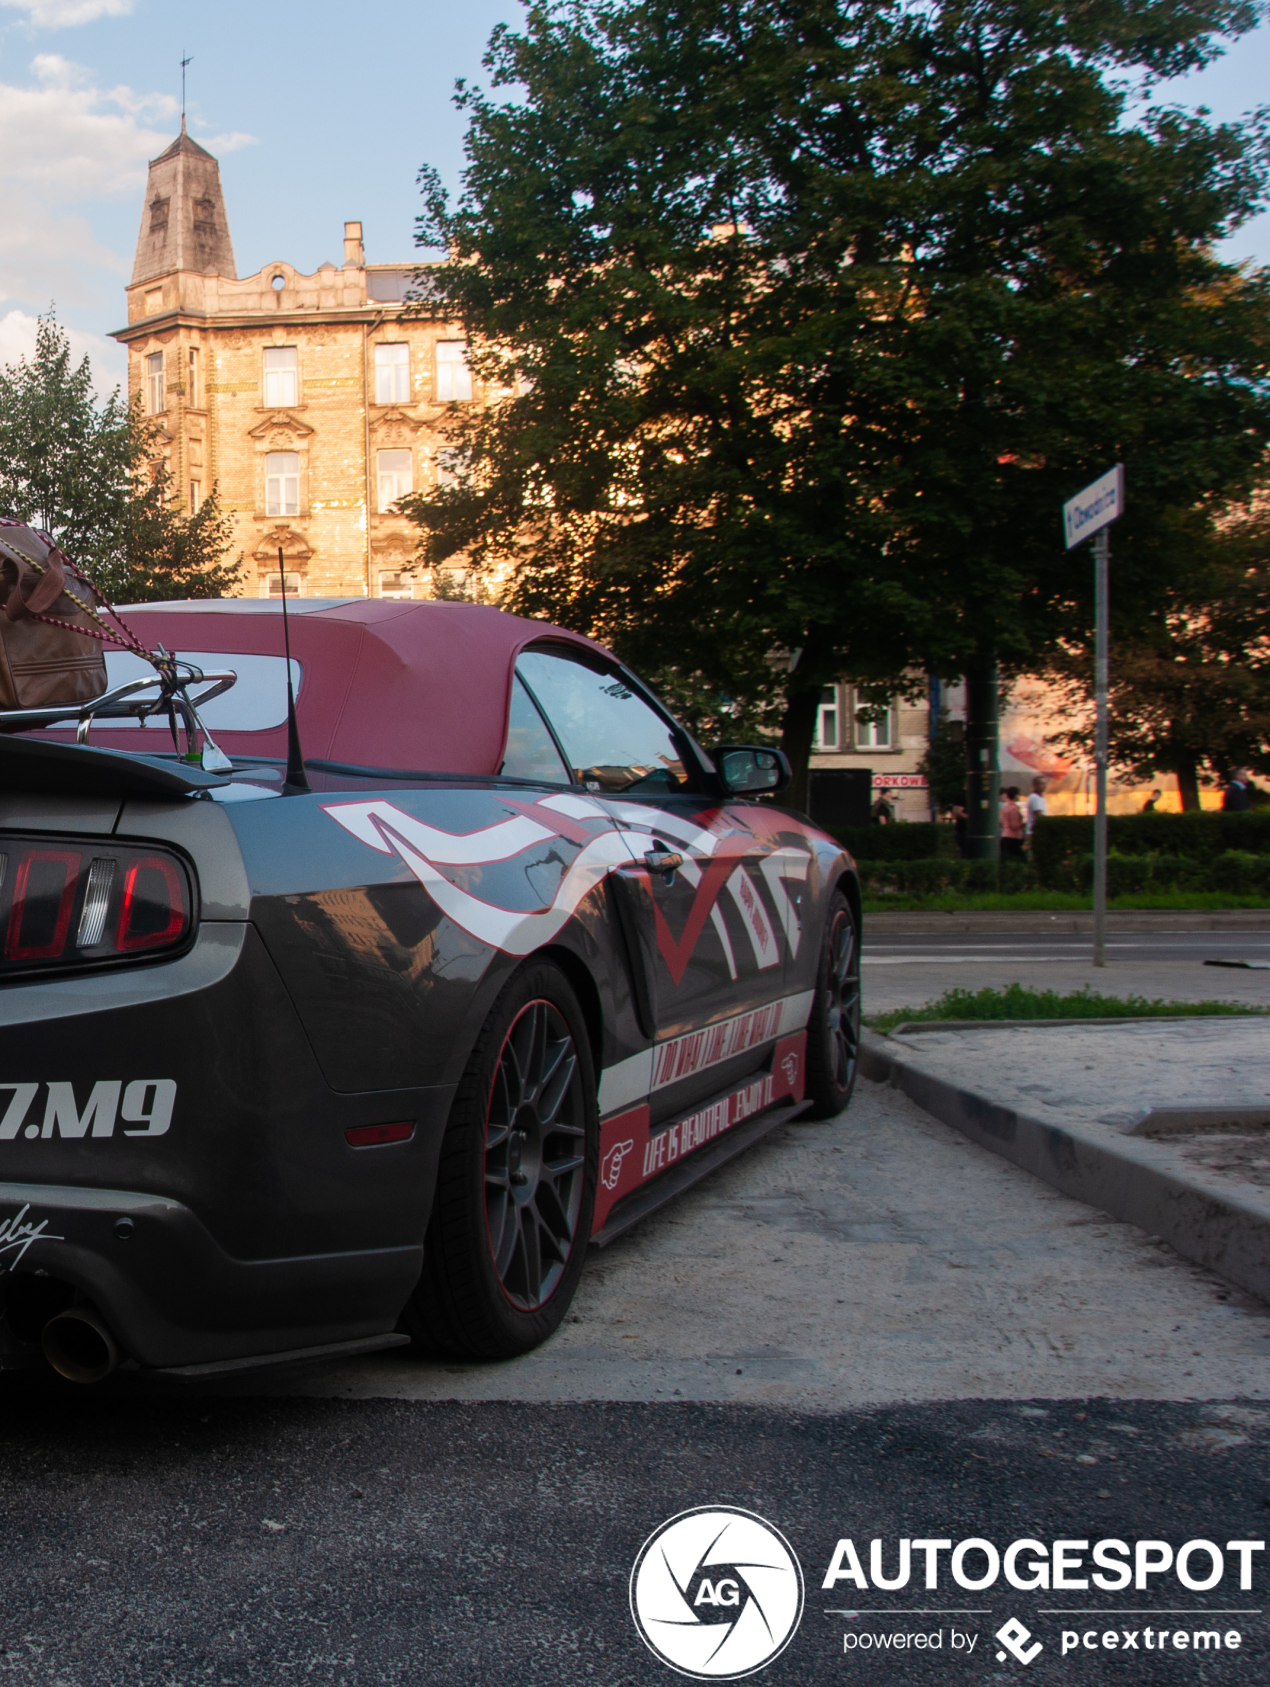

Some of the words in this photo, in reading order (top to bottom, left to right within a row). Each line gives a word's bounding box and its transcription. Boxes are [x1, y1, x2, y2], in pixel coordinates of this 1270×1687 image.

[653, 1046, 664, 1087] I
[659, 1040, 679, 1085] DO
[675, 1031, 706, 1078] WHAT
[731, 1014, 752, 1055] LIKE
[748, 1006, 771, 1047] WHAT
[642, 1131, 668, 1178] LIFE
[667, 1124, 680, 1163] IS
[679, 1097, 731, 1155] BEAUTIFUL
